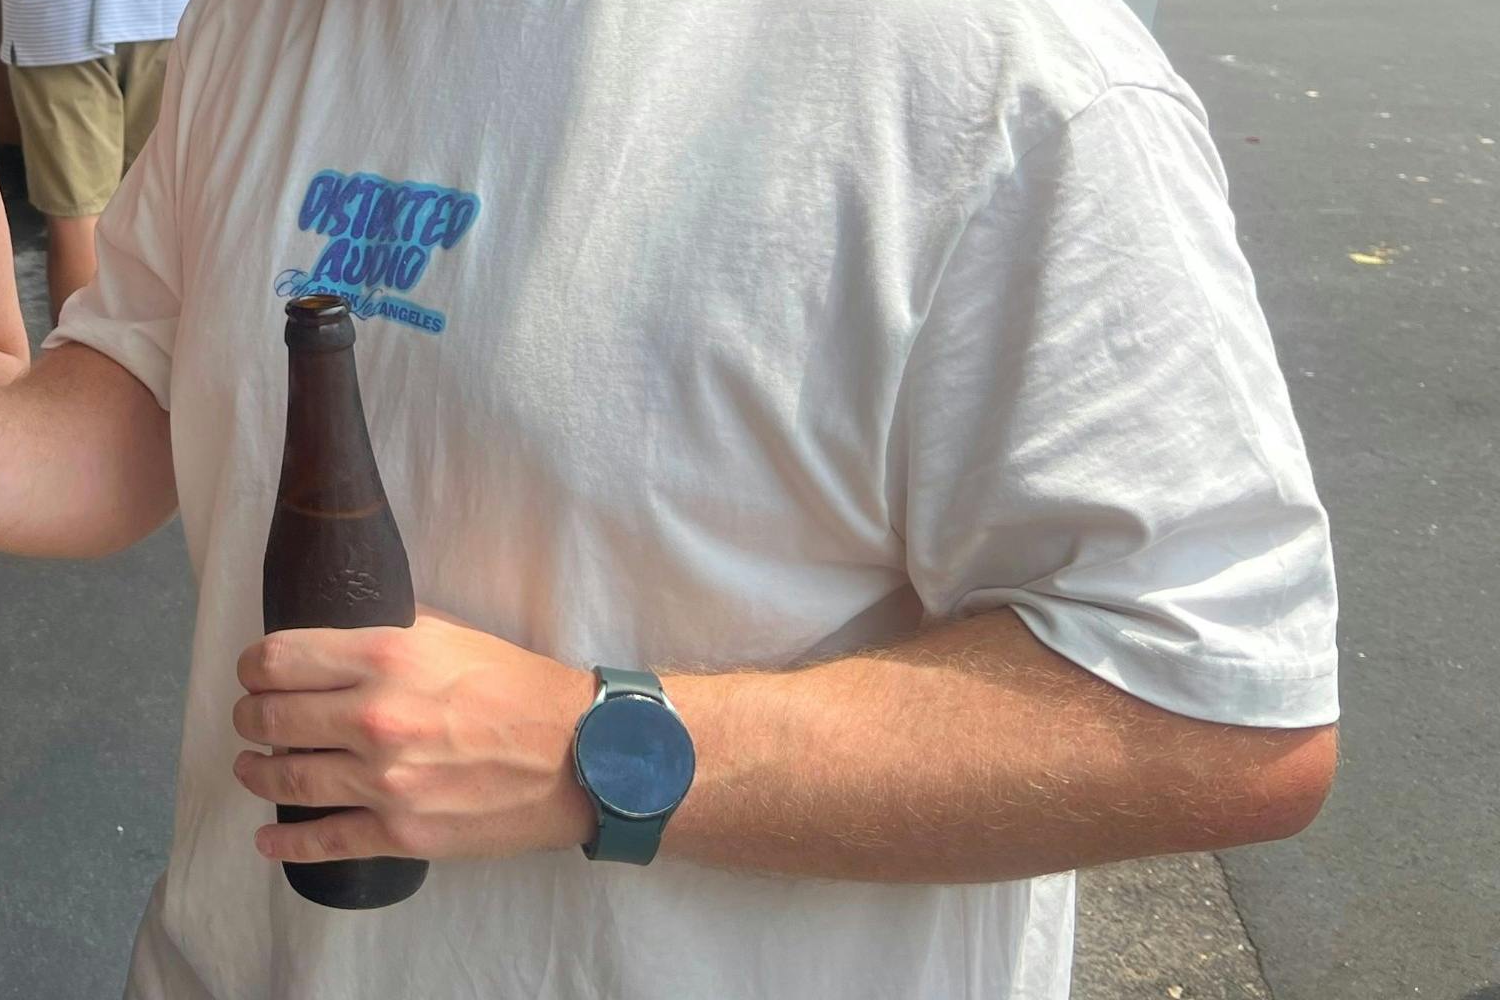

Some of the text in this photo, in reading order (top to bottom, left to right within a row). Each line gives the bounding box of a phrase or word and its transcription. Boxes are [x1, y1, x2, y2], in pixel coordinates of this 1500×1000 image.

[298, 175, 475, 250] DISTORTED
[313, 238, 427, 290] AUDIO
[379, 303, 444, 333] ANGELES
